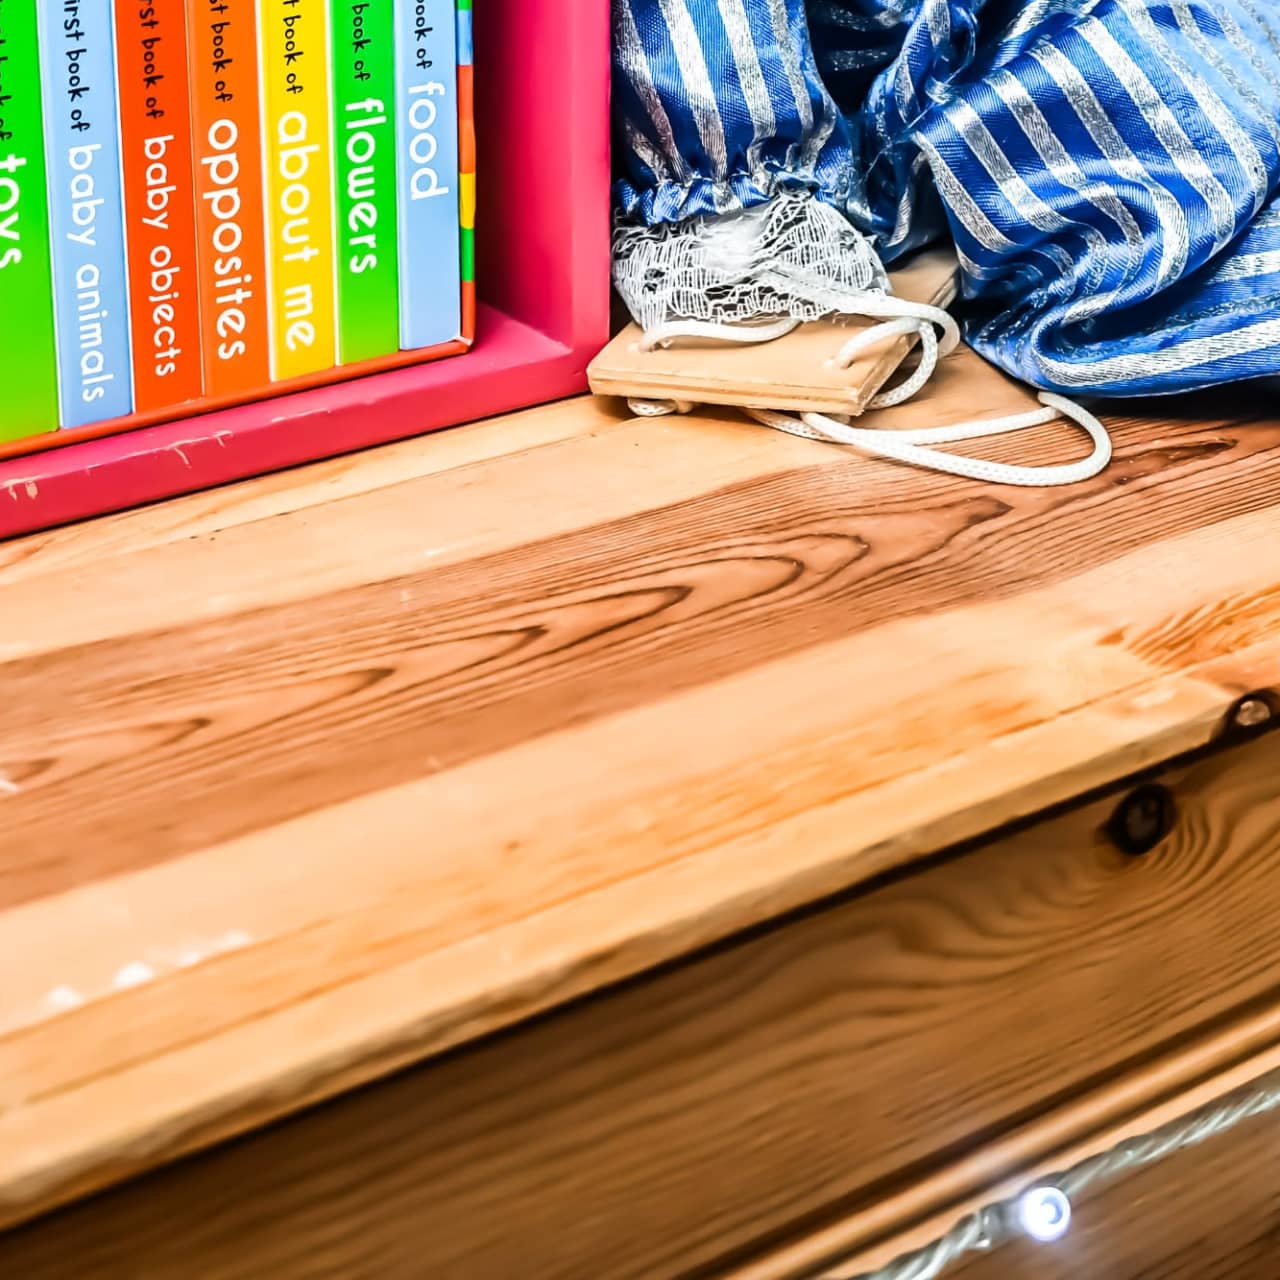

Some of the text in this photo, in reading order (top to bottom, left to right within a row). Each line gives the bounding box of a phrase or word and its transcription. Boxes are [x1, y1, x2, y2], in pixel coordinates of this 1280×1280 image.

[210, 21, 233, 73] book
[282, 14, 304, 66] book
[351, 3, 371, 53] book
[65, 48, 90, 102] book
[141, 37, 164, 88] book
[286, 72, 304, 94] of
[354, 60, 371, 81] of
[416, 48, 433, 70] of
[146, 97, 164, 118] of
[215, 80, 233, 102] of
[70, 109, 91, 132] of
[408, 81, 448, 200] food
[67, 144, 104, 245] baby
[143, 135, 176, 229] baby
[278, 111, 319, 261] about
[346, 98, 386, 273] flowers
[201, 119, 252, 359] opposites
[76, 264, 113, 401] animals
[149, 246, 181, 376] objects
[285, 285, 314, 350] me
